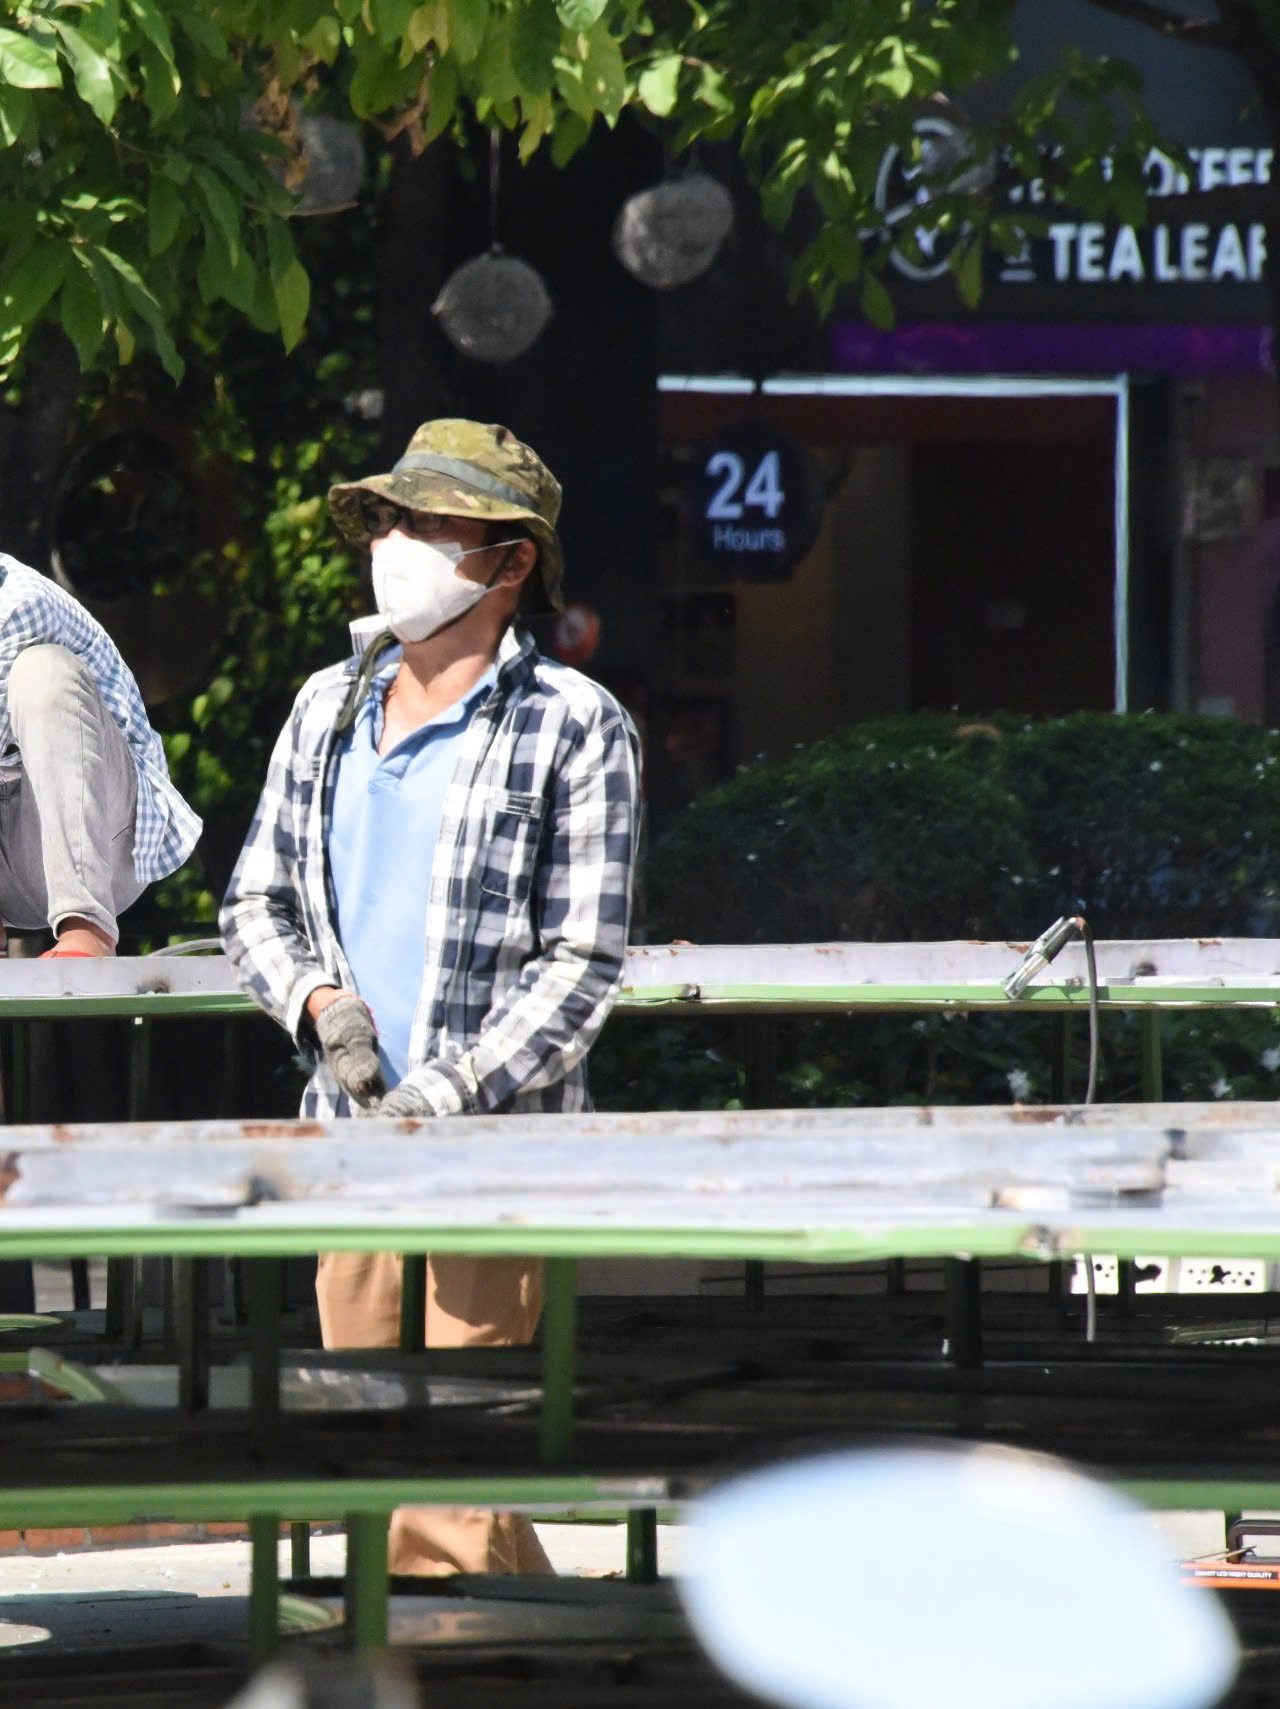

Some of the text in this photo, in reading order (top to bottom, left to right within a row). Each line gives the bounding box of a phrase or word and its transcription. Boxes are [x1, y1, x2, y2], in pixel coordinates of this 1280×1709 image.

[1048, 222, 1145, 282] TEA
[1153, 222, 1267, 282] LEAF
[705, 450, 785, 519] 24
[713, 523, 786, 551] Hours
